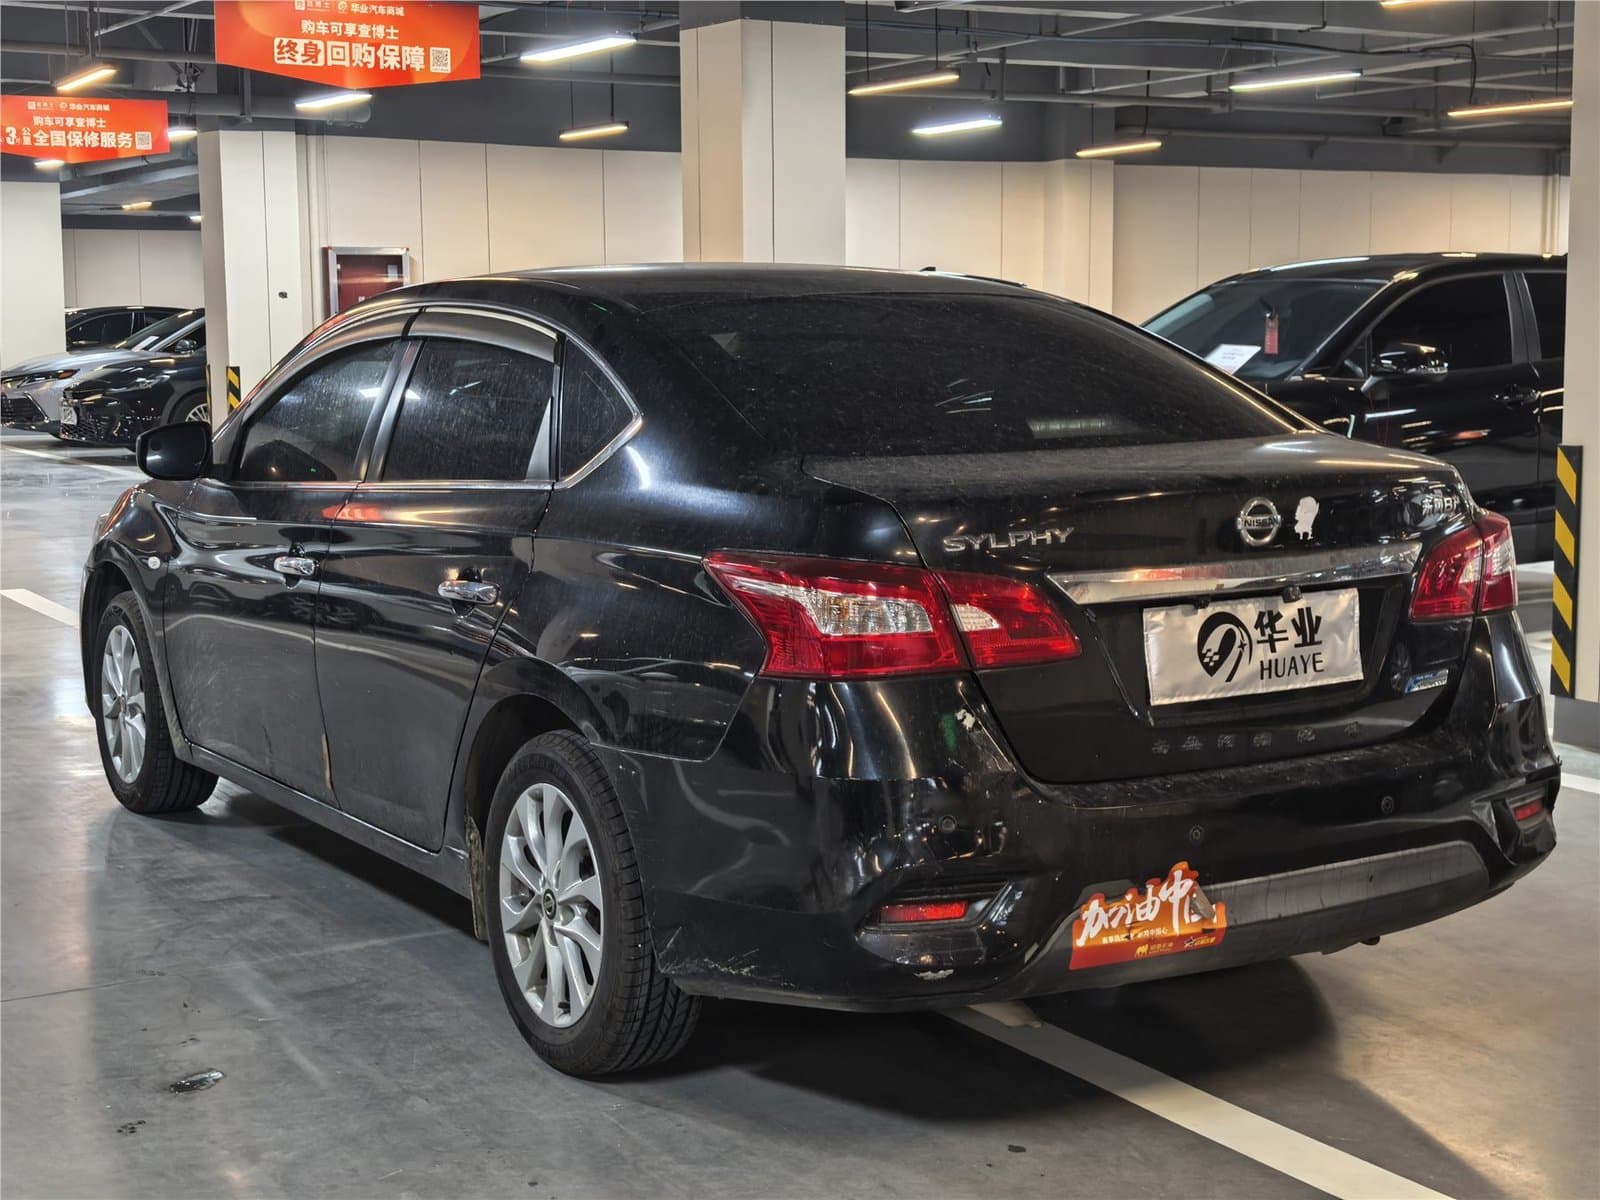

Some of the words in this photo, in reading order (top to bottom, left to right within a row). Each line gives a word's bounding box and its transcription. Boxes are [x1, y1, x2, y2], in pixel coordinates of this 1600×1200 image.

[301, 20, 399, 40] 购车可享查博士
[275, 38, 426, 71] 终身回购保障
[33, 116, 107, 128] 购车可享查博士
[943, 527, 1075, 552] SYLPHY
[1254, 606, 1322, 653] 华业
[1260, 652, 1325, 680] HUAYE
